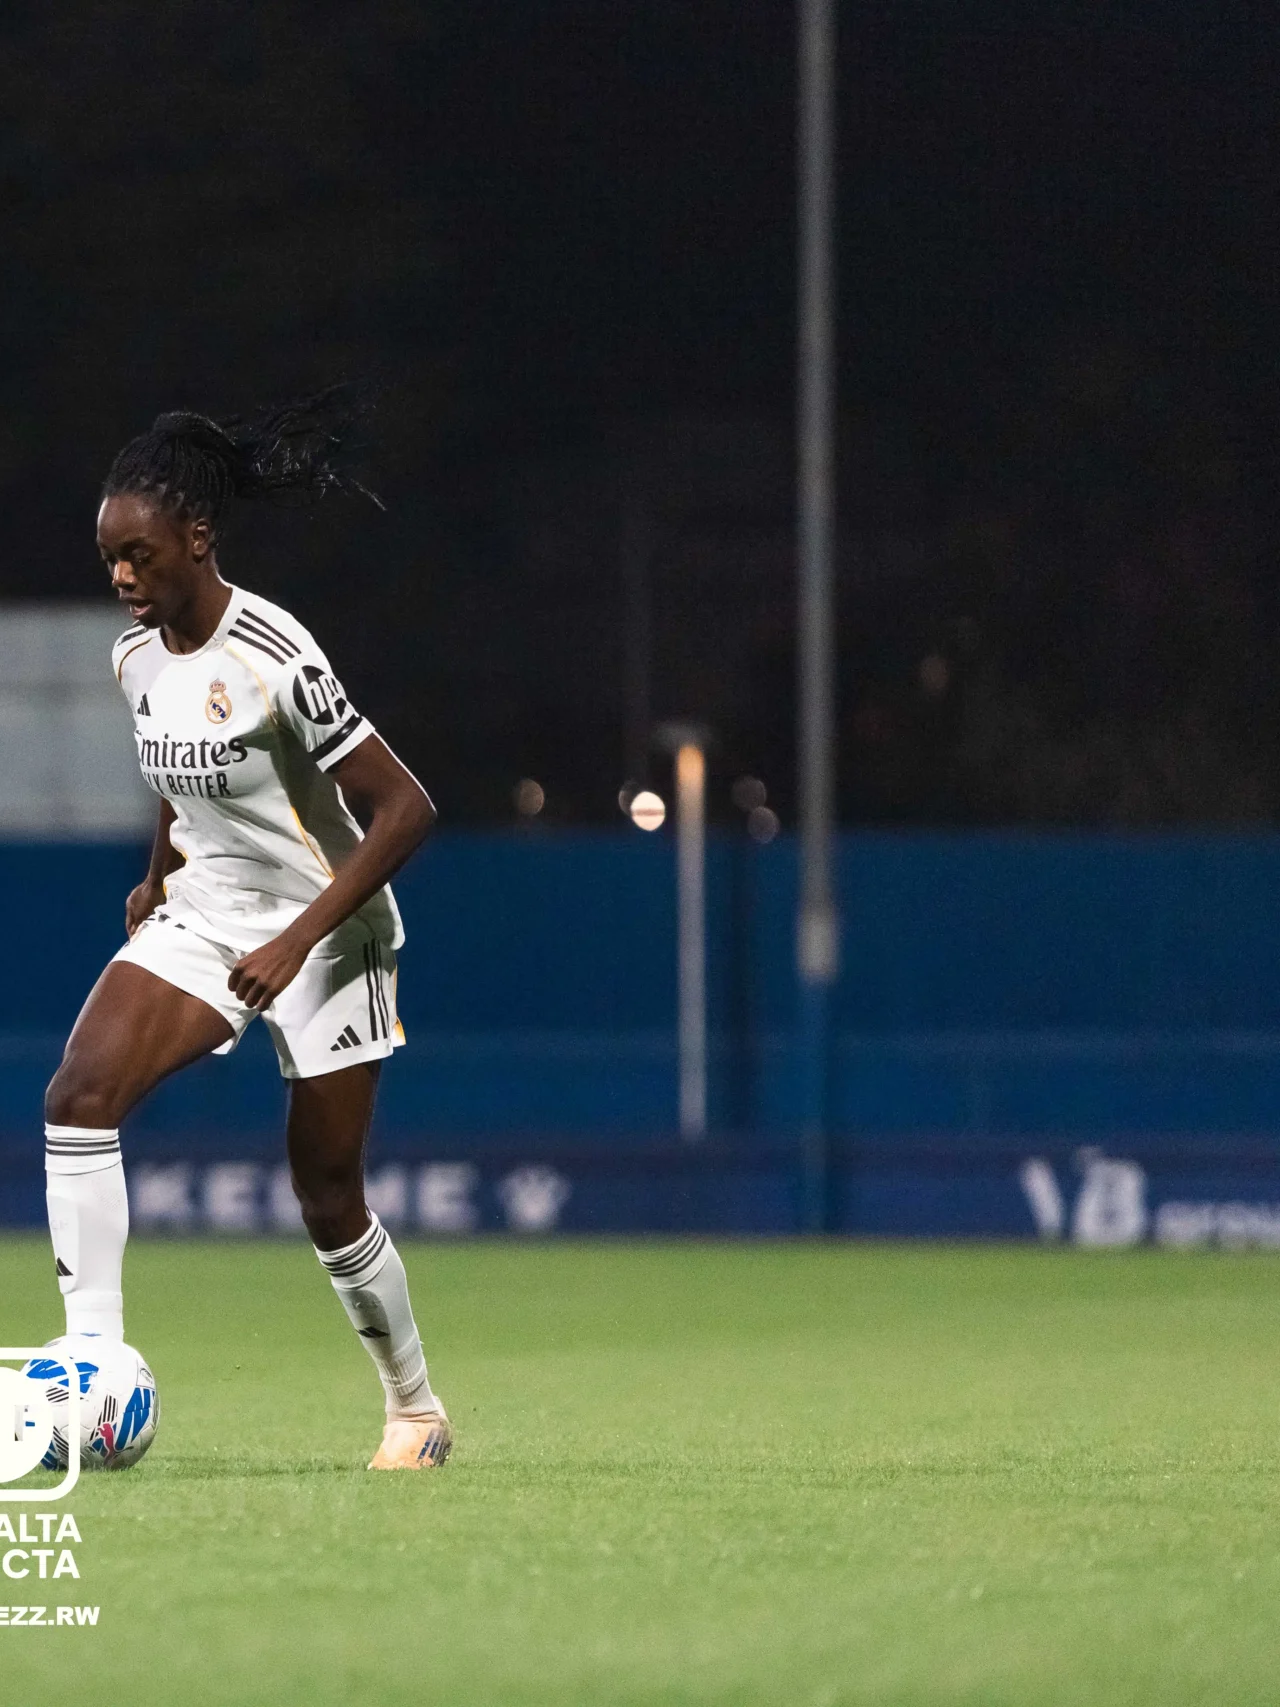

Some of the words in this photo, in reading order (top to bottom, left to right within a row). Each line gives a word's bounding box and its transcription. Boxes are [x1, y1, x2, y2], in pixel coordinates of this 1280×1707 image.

[294, 665, 349, 725] hp
[135, 730, 248, 768] mirates
[143, 772, 165, 795] LY
[166, 771, 232, 799] BETTER
